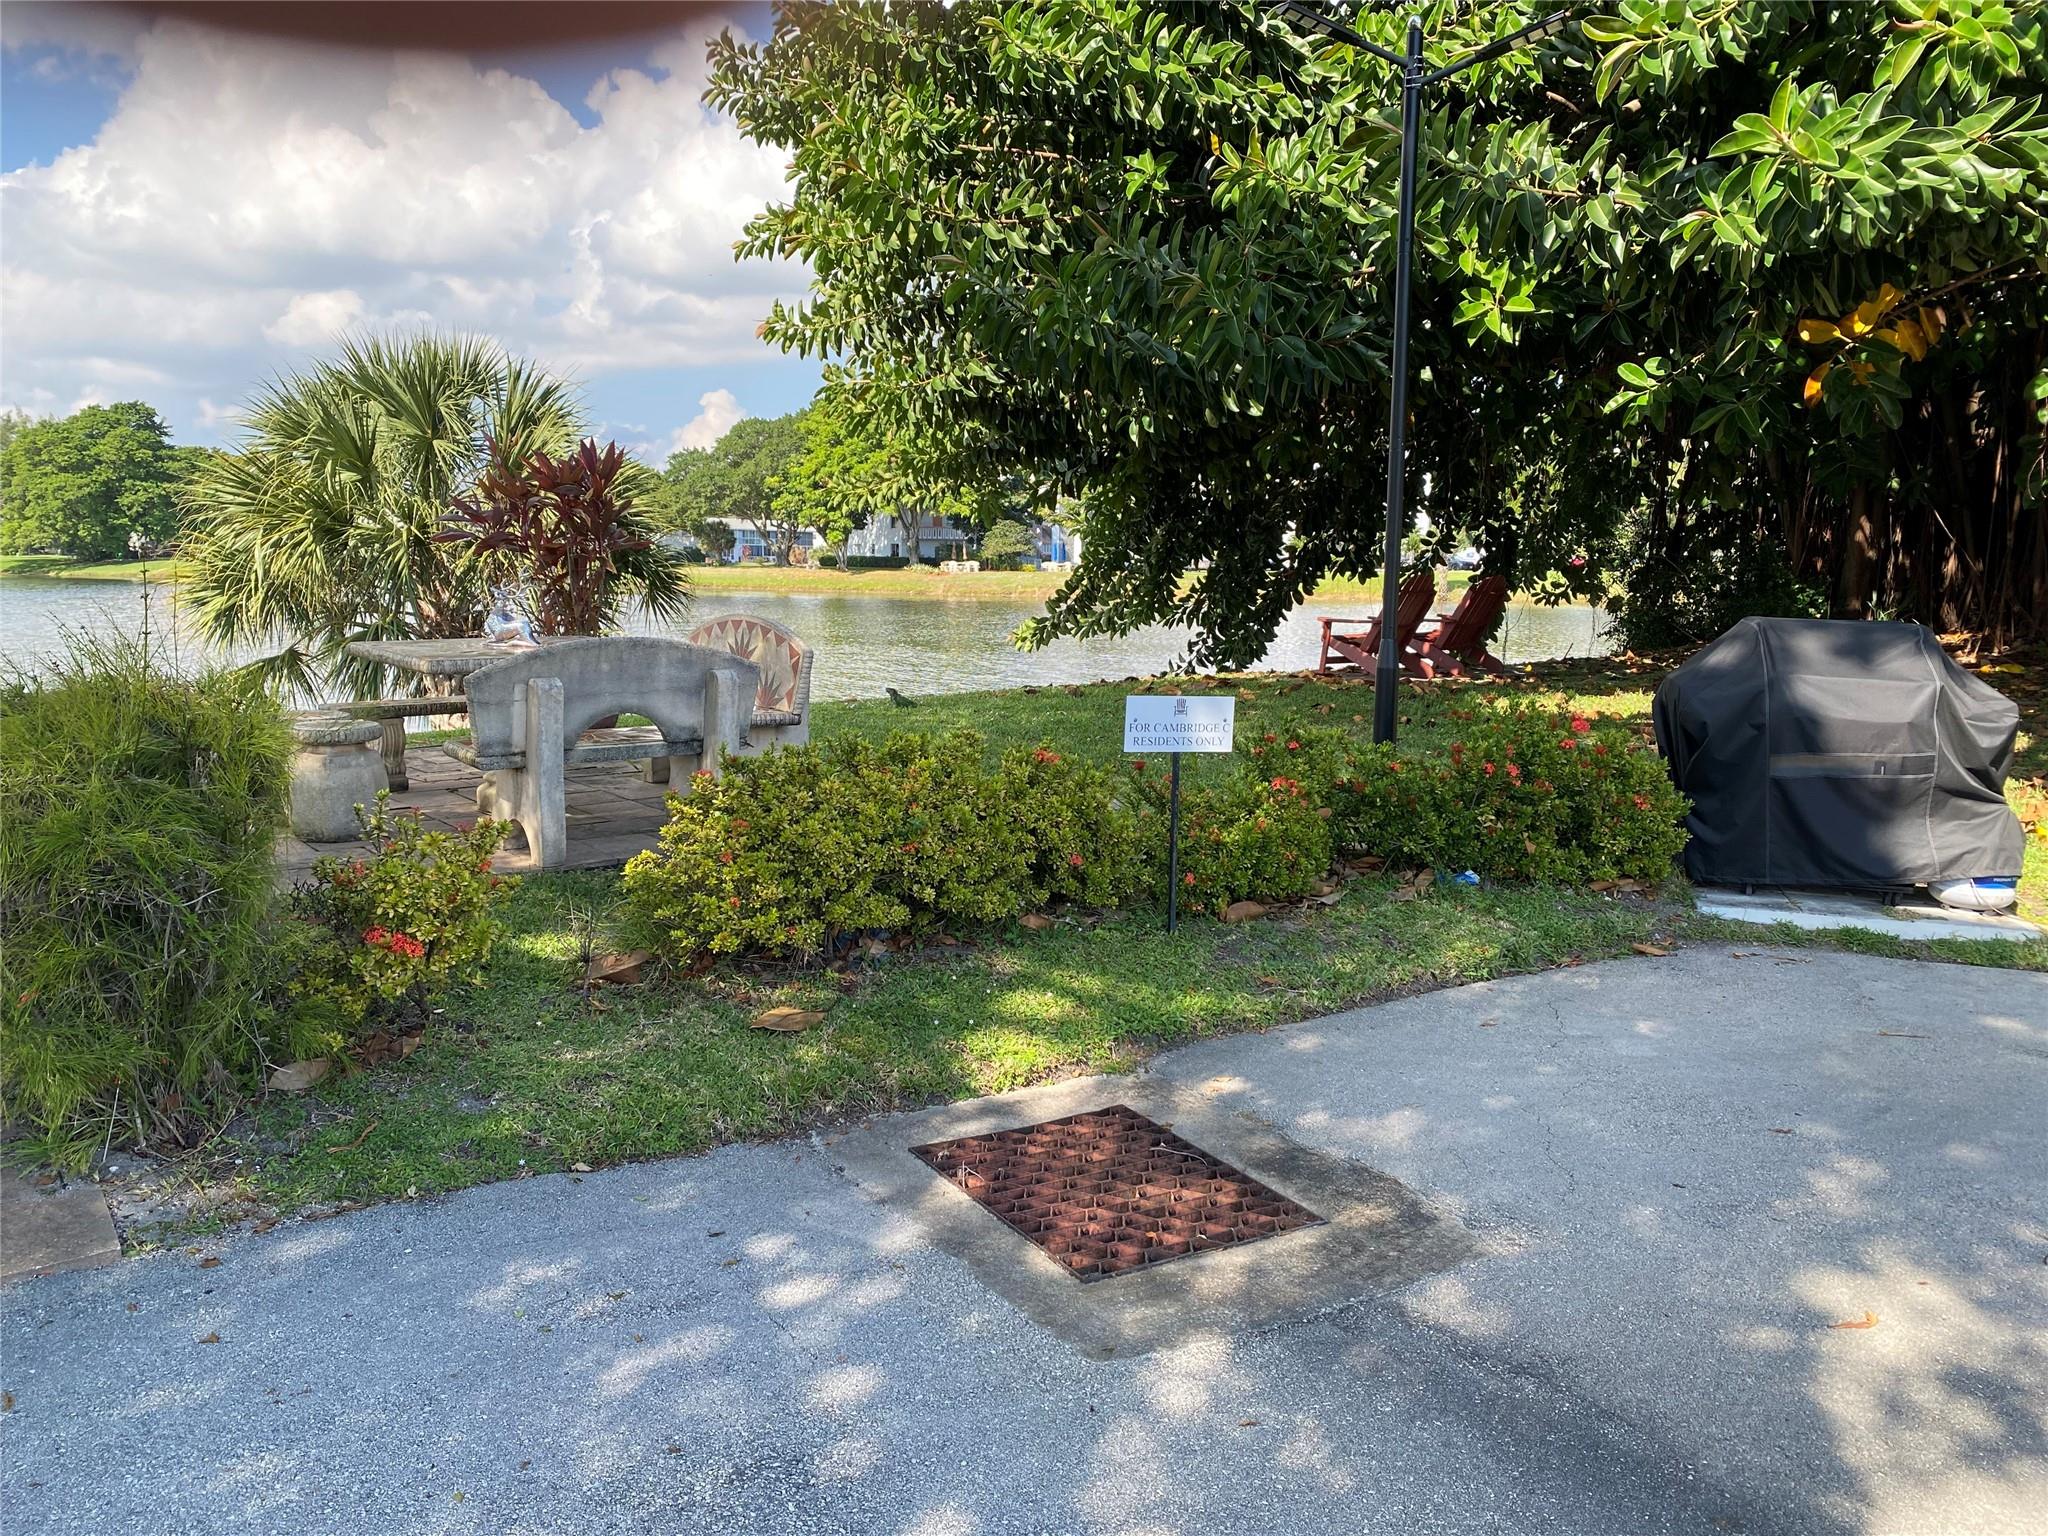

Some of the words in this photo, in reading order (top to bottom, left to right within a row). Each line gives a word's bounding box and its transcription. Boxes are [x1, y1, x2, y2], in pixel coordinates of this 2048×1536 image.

[1129, 723, 1151, 733] FOR
[1153, 723, 1220, 733] CAMBRIDGE
[1222, 723, 1231, 733] C
[1133, 736, 1193, 746] RESIDENTS
[1195, 736, 1225, 746] ONLY
